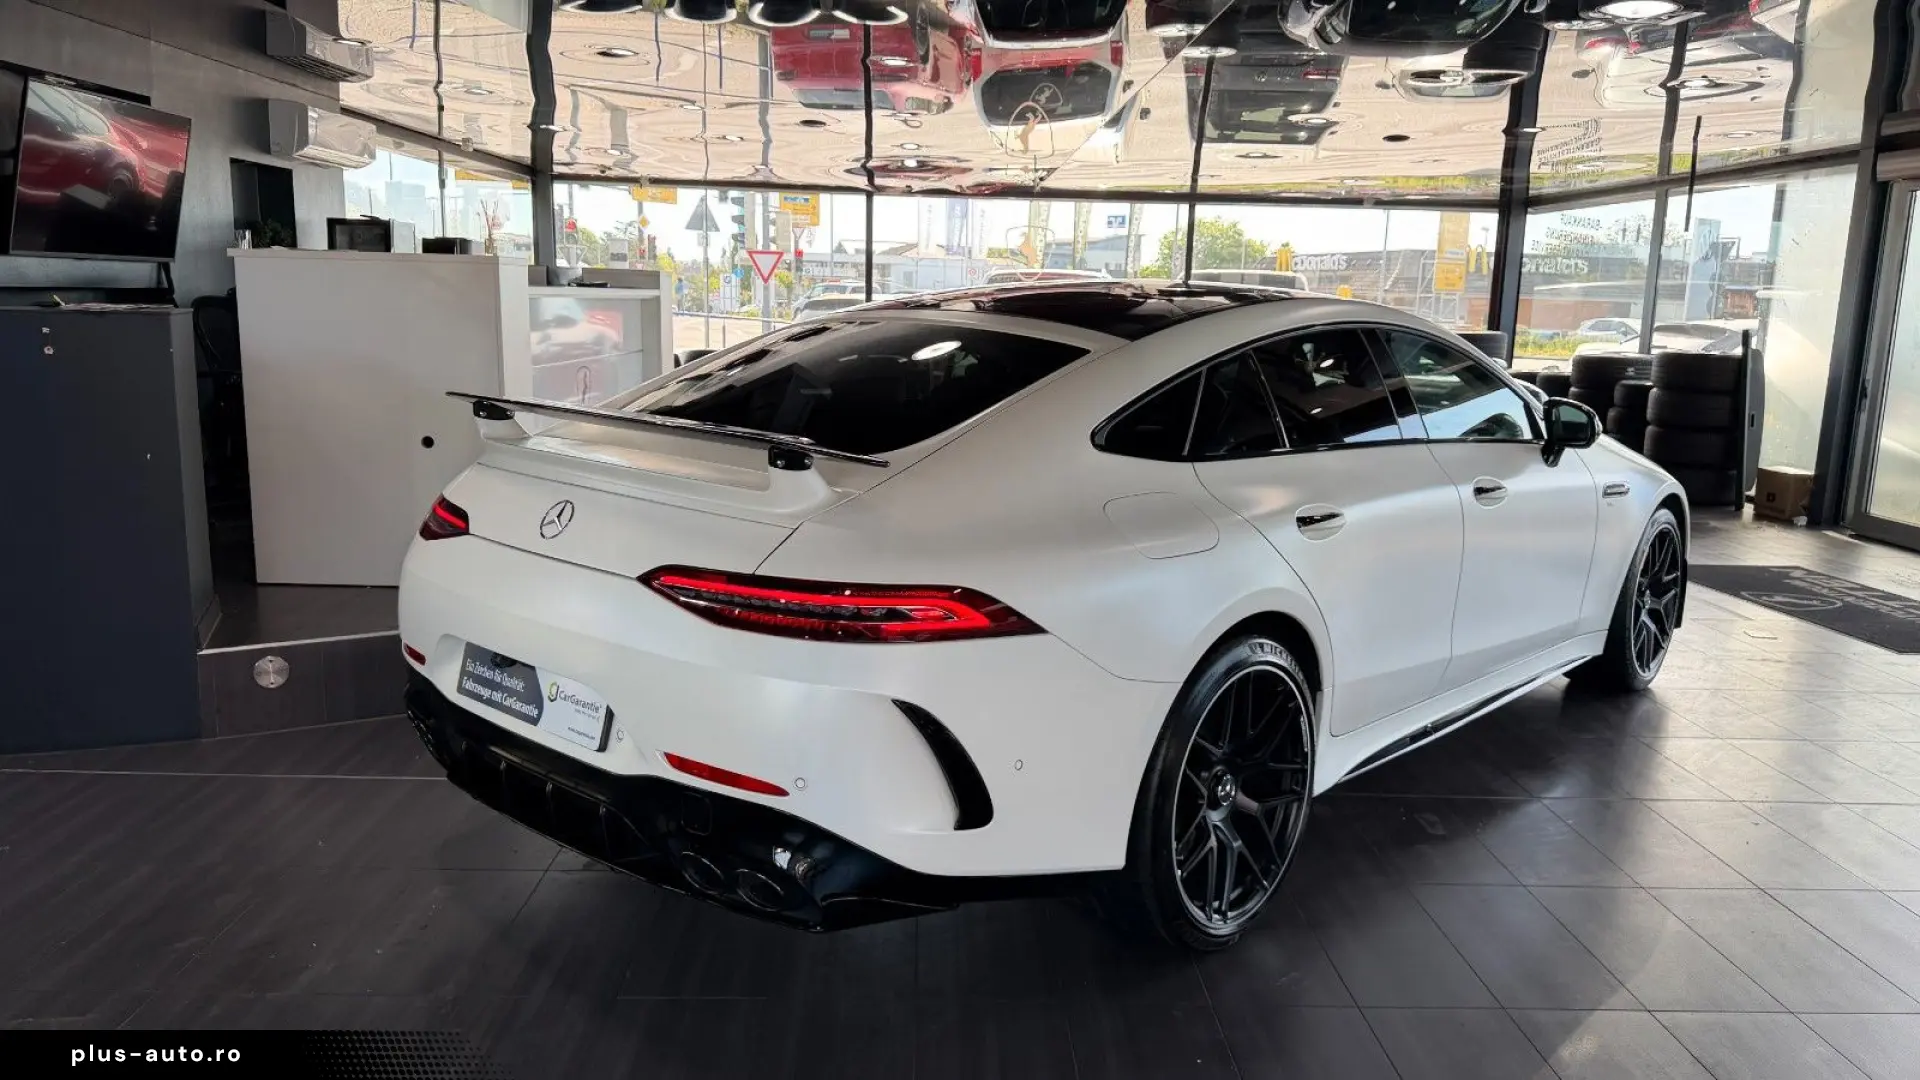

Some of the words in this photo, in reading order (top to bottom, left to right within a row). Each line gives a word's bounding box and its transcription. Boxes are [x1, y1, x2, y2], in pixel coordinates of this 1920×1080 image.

[462, 676, 492, 699] Fahrzeuge
[492, 690, 503, 703] mit
[503, 693, 539, 718] CarGarantie
